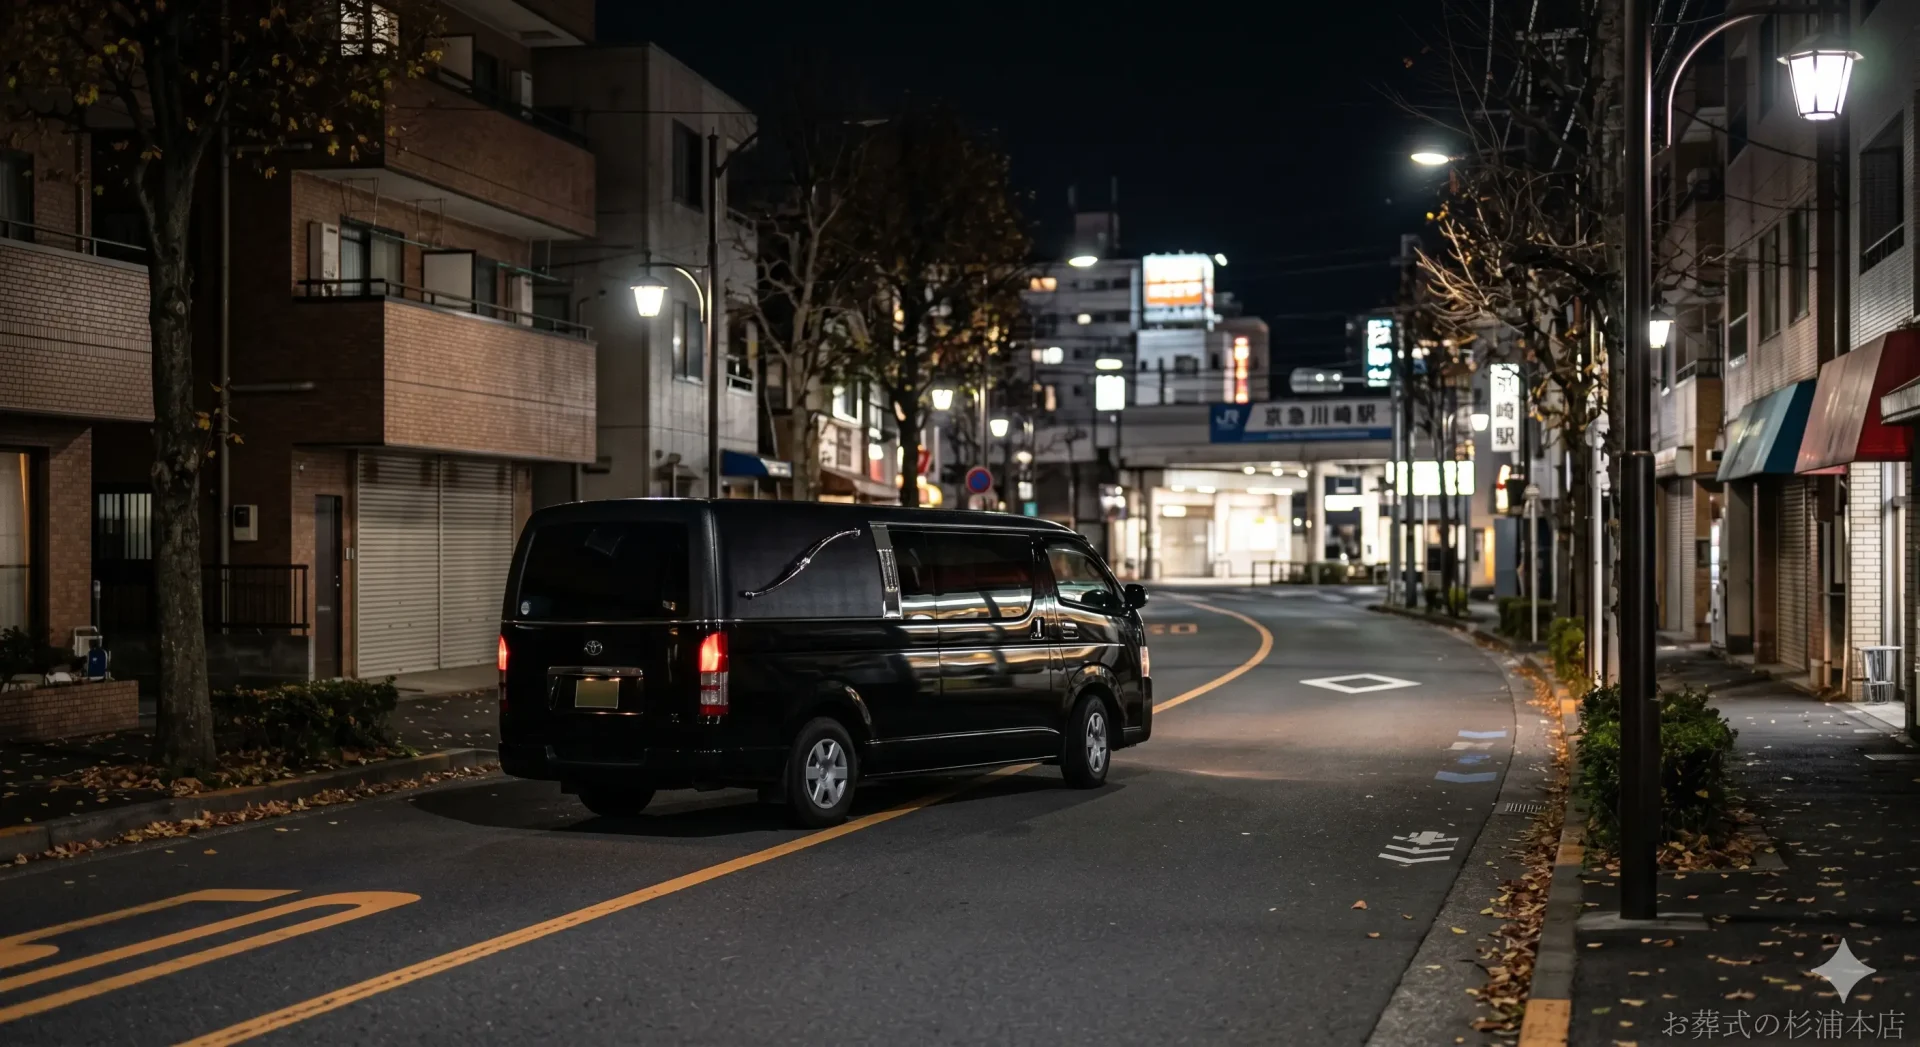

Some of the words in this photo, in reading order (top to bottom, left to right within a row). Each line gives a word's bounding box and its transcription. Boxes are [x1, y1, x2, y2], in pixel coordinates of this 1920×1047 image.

[1216, 409, 1239, 425] JR
[1264, 404, 1376, 427] 京急川崎駅
